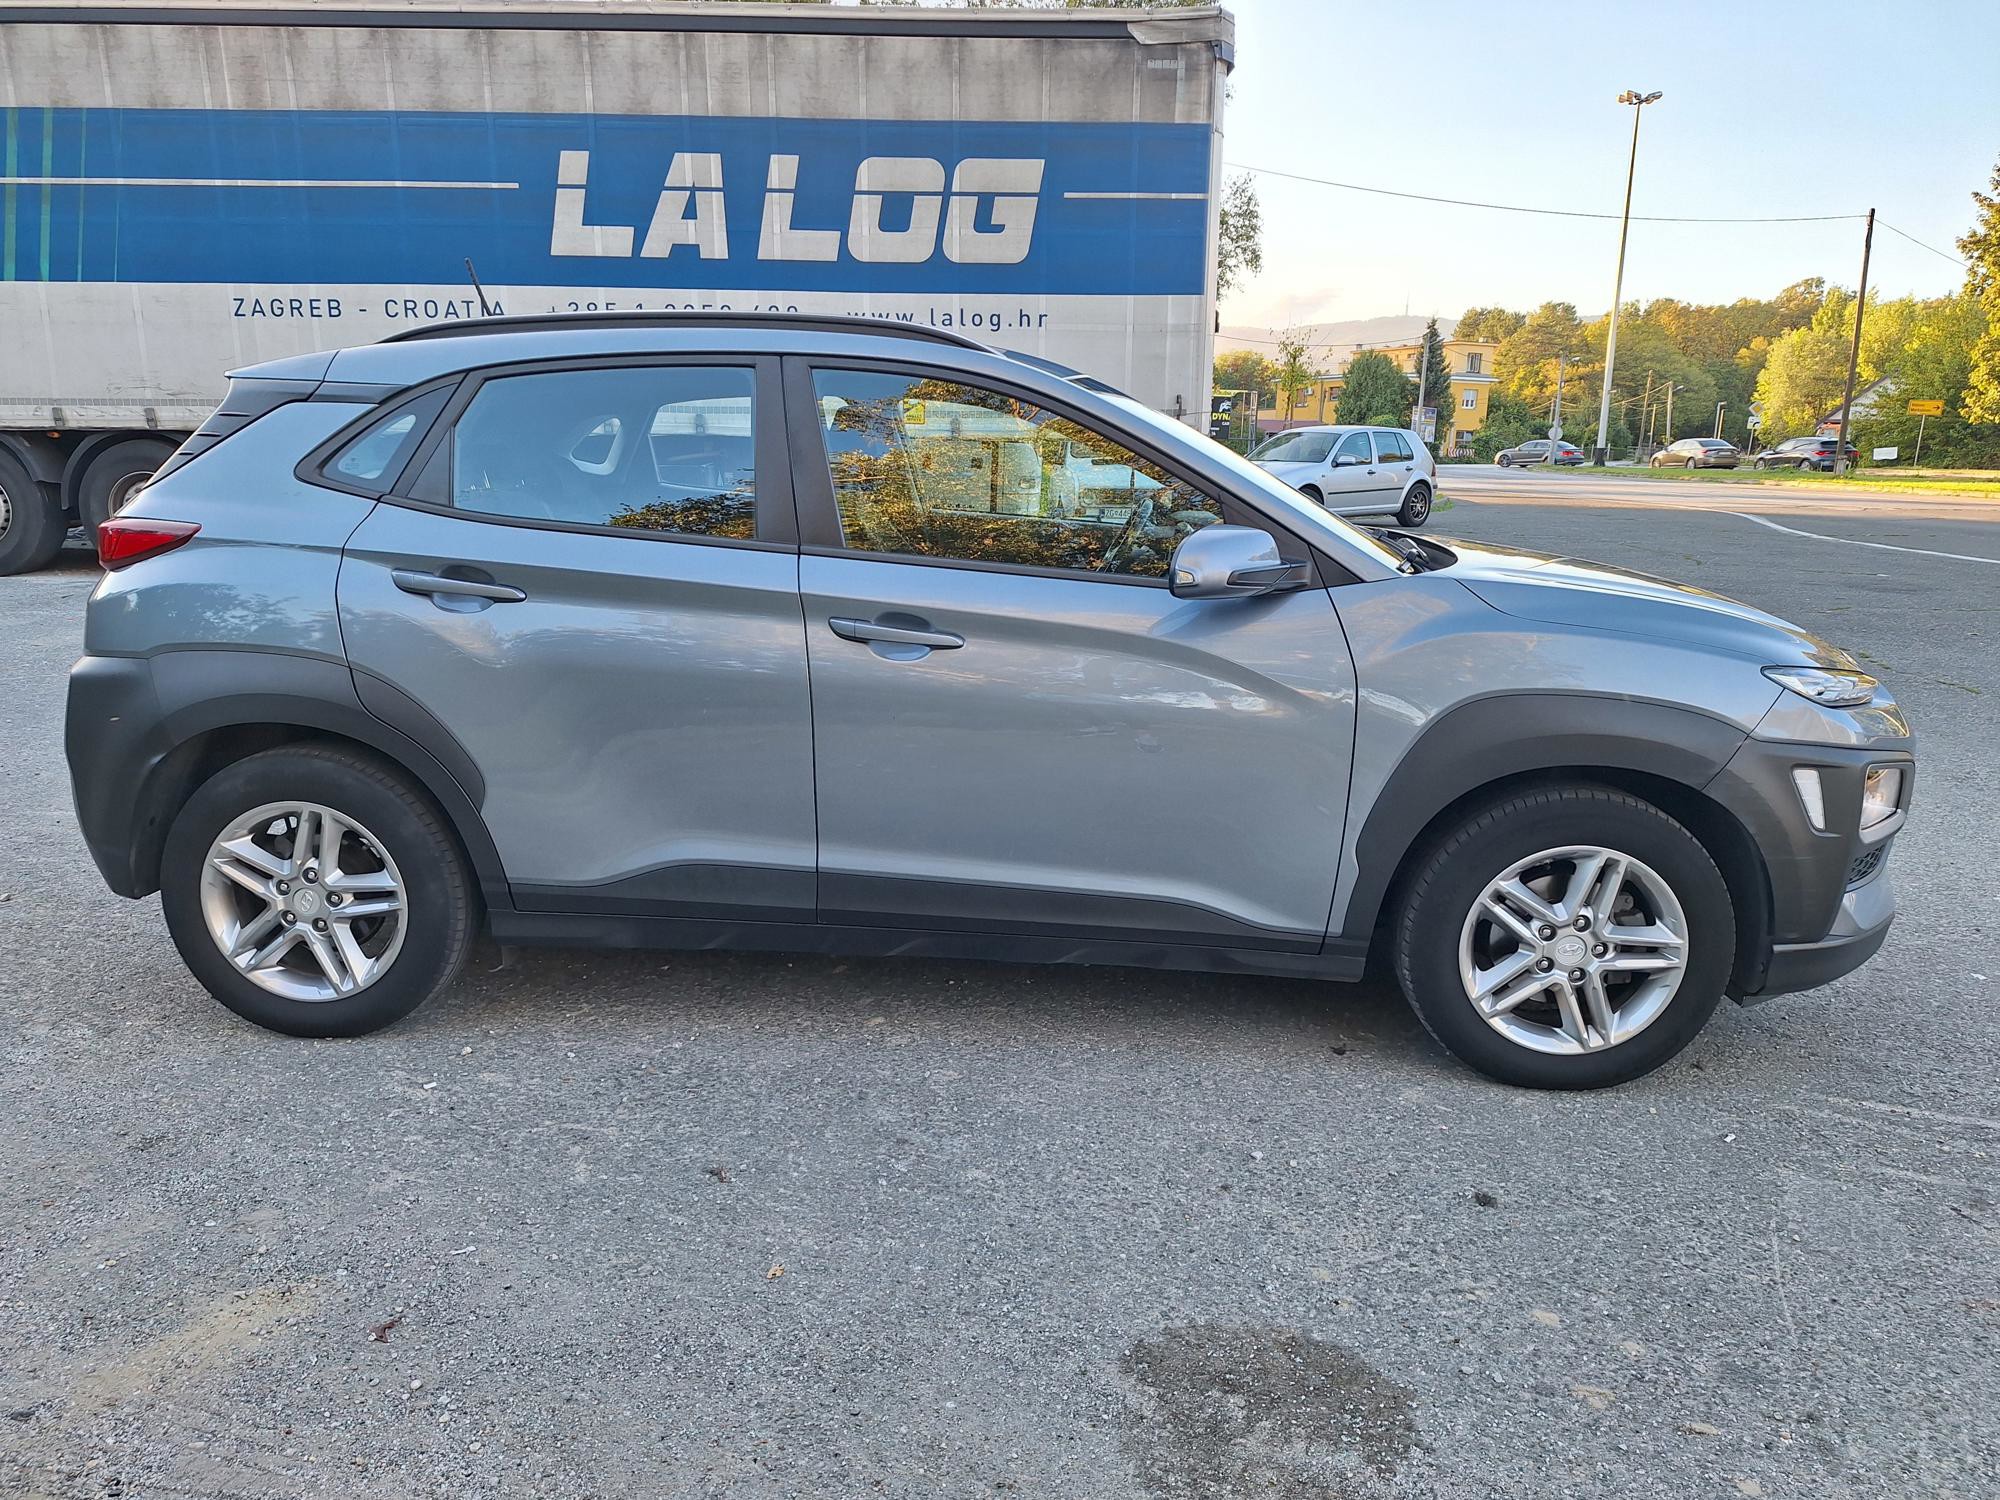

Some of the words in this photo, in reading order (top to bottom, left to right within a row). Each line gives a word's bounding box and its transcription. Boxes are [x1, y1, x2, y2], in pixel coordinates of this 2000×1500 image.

[551, 150, 729, 260] LA
[757, 154, 1046, 264] LOG
[233, 297, 342, 318] ZAGREB
[384, 299, 505, 318] CROATIA
[847, 308, 1048, 331] ww.lalog.hr
